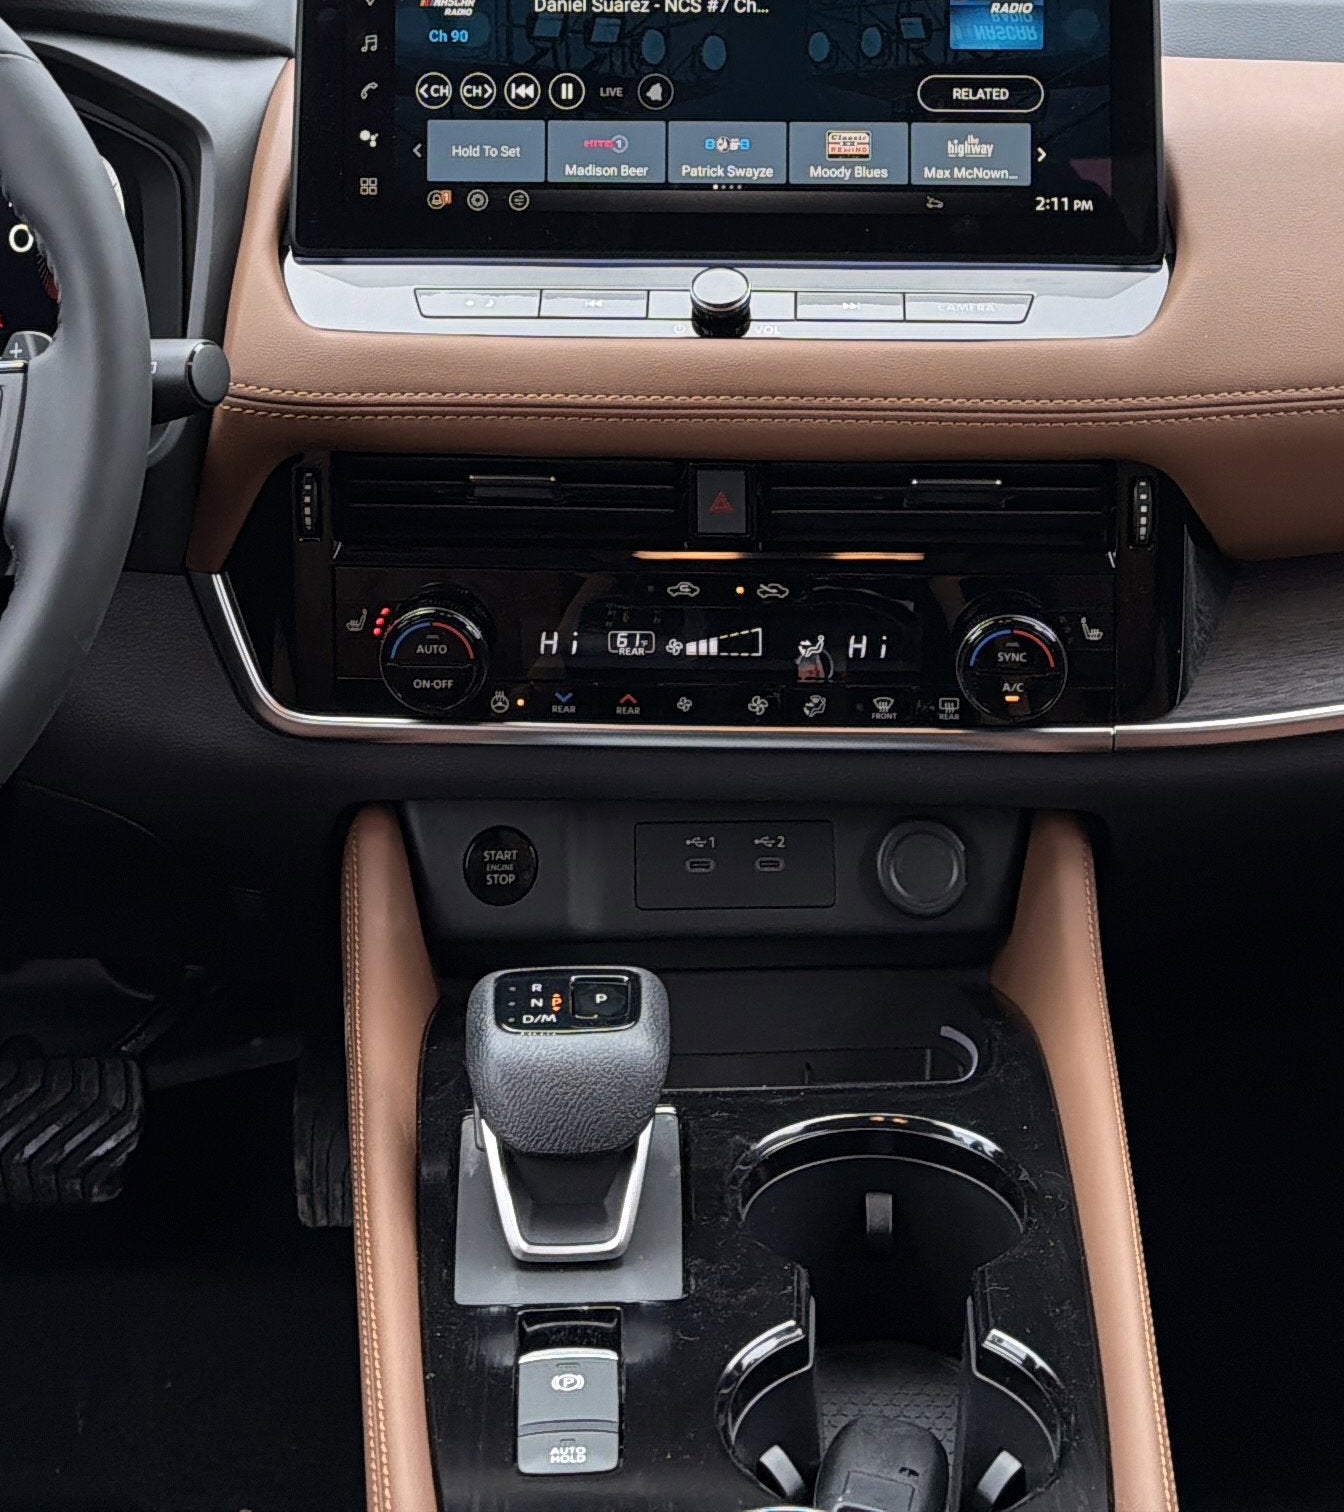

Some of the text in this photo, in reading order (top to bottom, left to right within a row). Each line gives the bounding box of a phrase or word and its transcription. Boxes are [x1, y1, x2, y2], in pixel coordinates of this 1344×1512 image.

[990, 3, 1034, 14] RADIO
[429, 30, 469, 43] Ch 90
[430, 85, 449, 97] CH
[463, 85, 482, 97] CH
[600, 86, 623, 98] LIVE
[952, 88, 1009, 100] RELATED
[452, 145, 521, 158] Hold To Set
[947, 140, 994, 157] highway
[565, 164, 648, 176] Madison Beer
[682, 165, 774, 180] Patrick Swayze
[809, 166, 888, 180] Moody Blues
[924, 167, 951, 179] Max
[1035, 197, 1094, 211] 2:11 PM
[938, 303, 996, 313] CAMERA
[755, 326, 781, 335] VOL
[416, 644, 447, 655] AUTO
[618, 647, 645, 656] REAR
[997, 652, 1027, 663] SYNC
[1002, 682, 1024, 693] A/C
[552, 705, 576, 714] REAR
[616, 706, 640, 715] REAR
[871, 712, 897, 720] FRONT
[709, 837, 715, 848] 1
[777, 836, 785, 848] 2
[483, 850, 518, 862] START
[486, 863, 514, 872] ENGINE
[486, 874, 516, 886] STOP
[531, 984, 542, 992] R
[530, 998, 562, 1007] N P
[596, 994, 608, 1004] P
[522, 1014, 557, 1024] D/M
[549, 1446, 586, 1455] AUTO
[550, 1455, 586, 1464] HOLD
